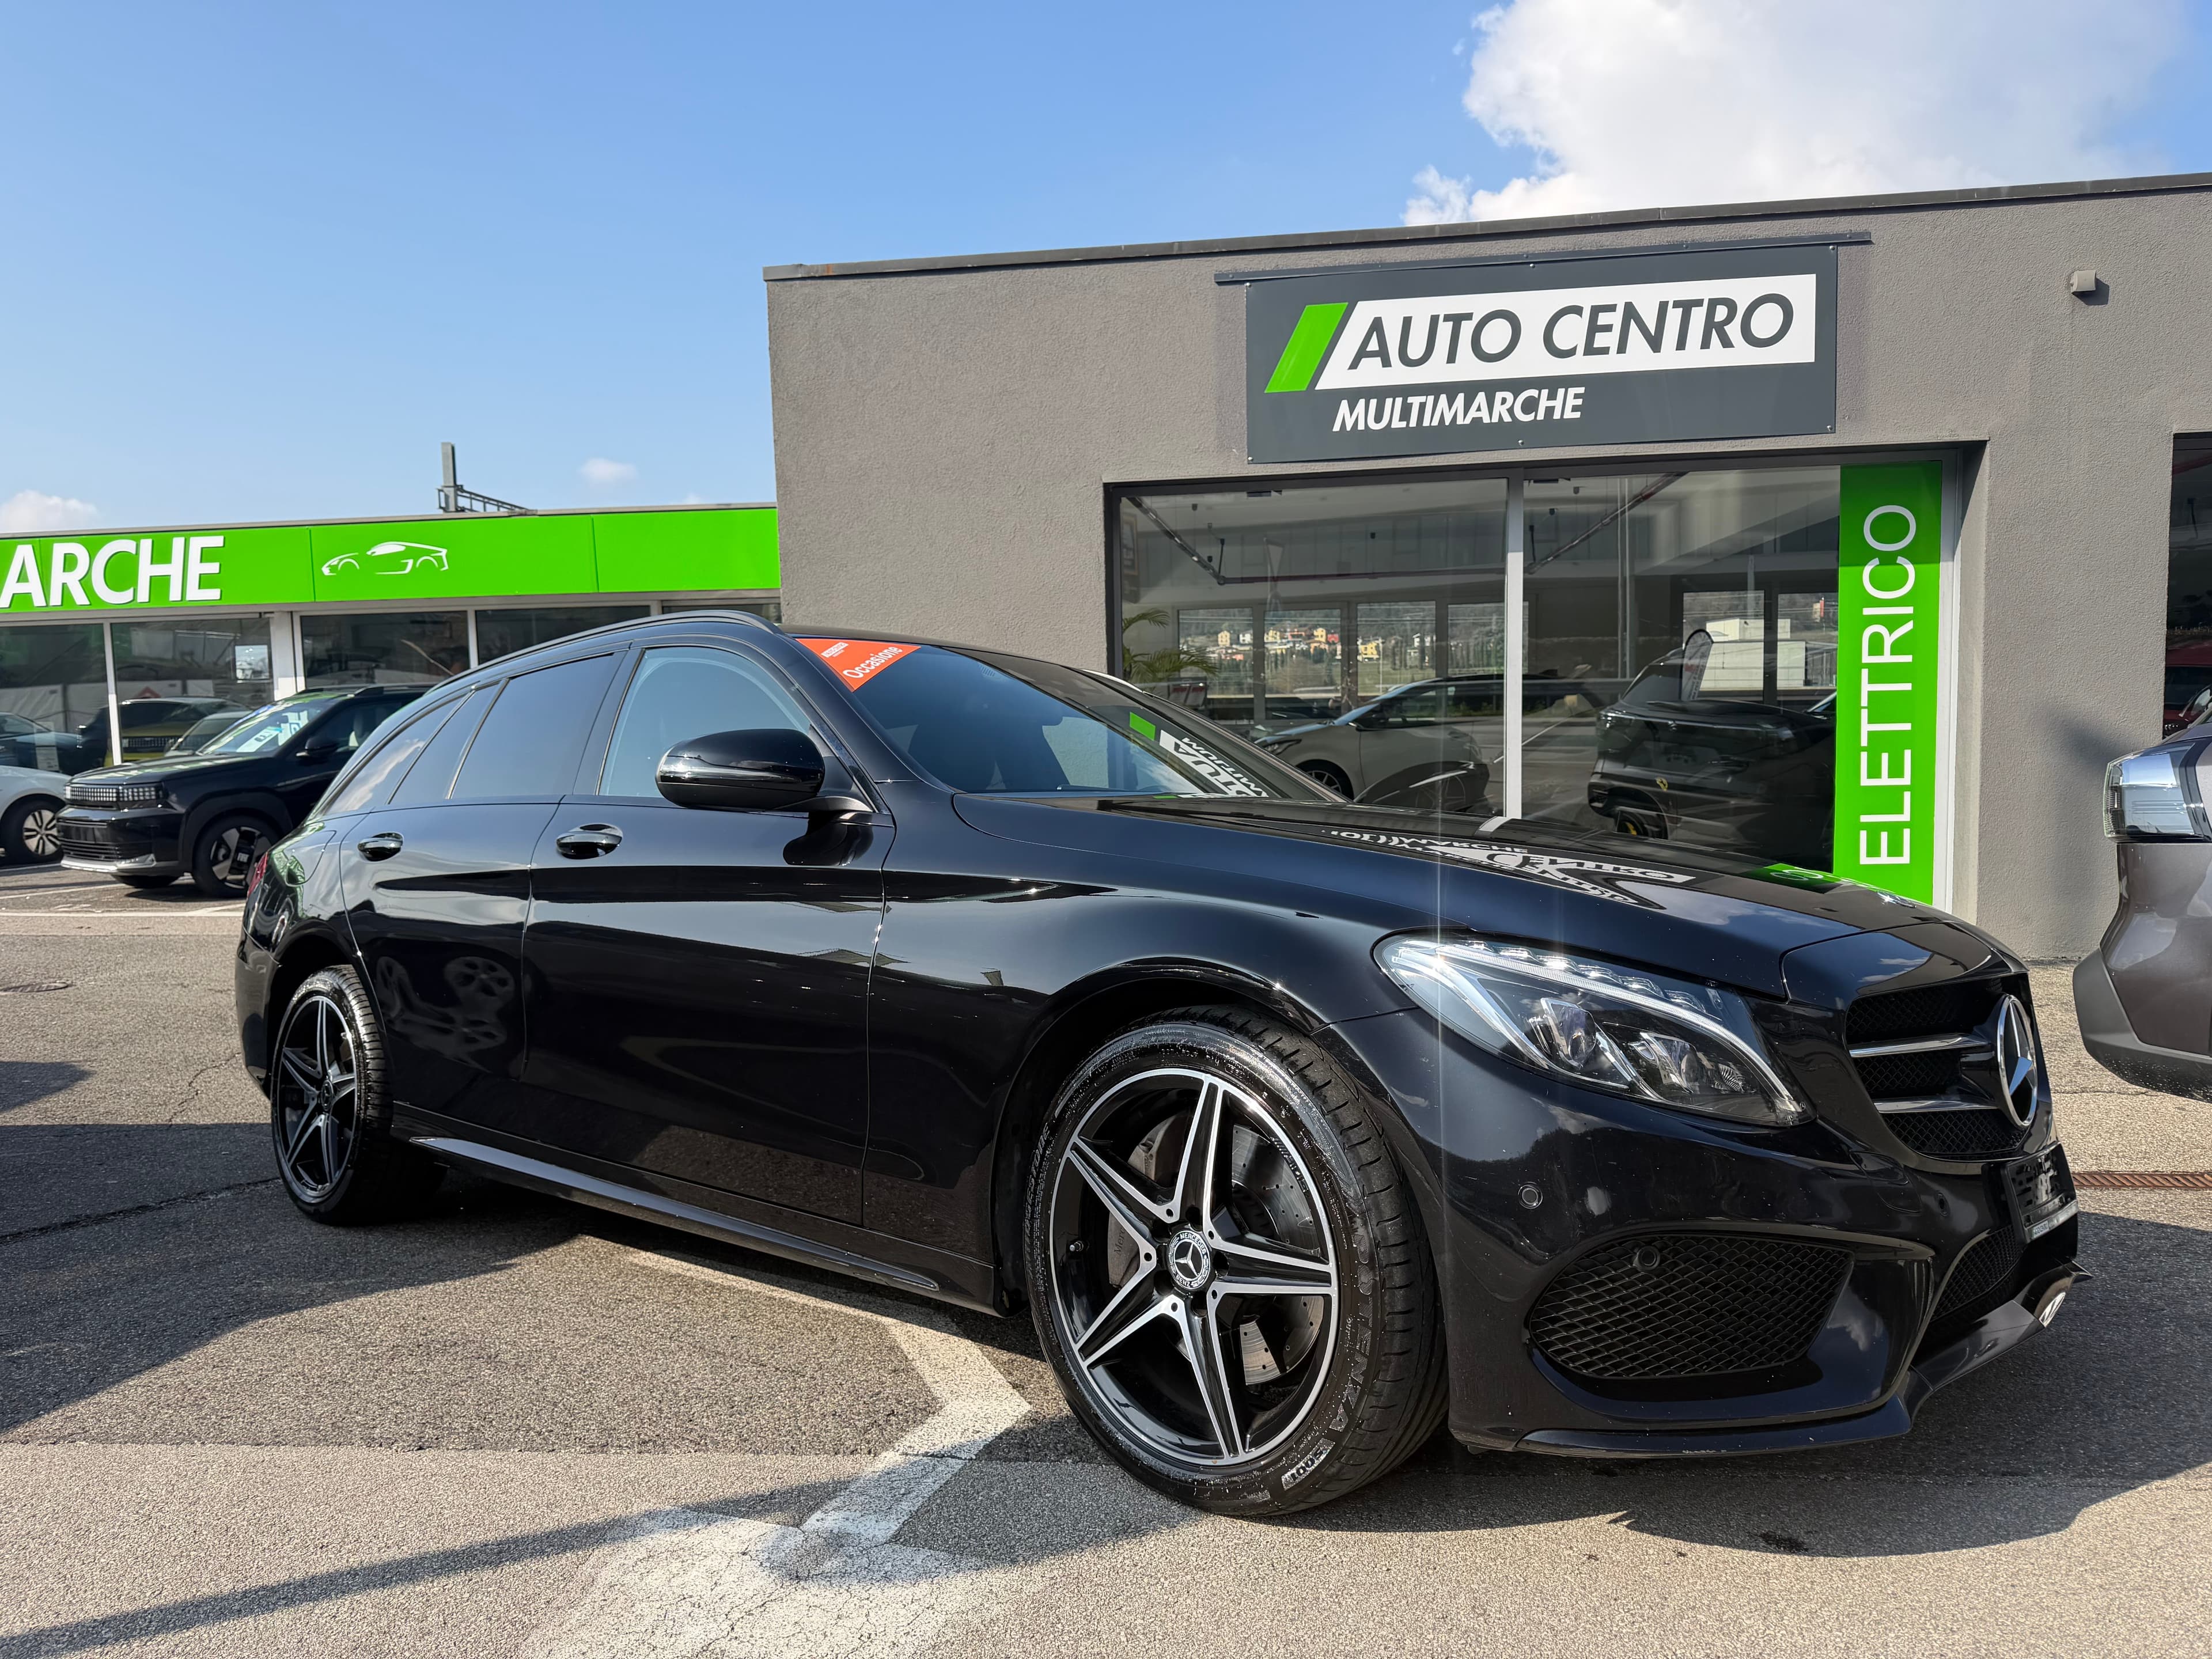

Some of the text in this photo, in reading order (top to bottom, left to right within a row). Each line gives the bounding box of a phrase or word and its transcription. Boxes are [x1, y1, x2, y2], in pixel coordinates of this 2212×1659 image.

[1348, 293, 1794, 370] AUTO CENTRO
[1332, 387, 1585, 432] MULTIMARCHE
[0, 535, 225, 608] ARCHE
[842, 646, 903, 679] Occasione
[1859, 505, 1916, 865] ELETTRICO
[1179, 1232, 1207, 1255] MERCEDES
[1176, 1274, 1191, 1287] BENZ
[1328, 1234, 1374, 1432] POTENZA
